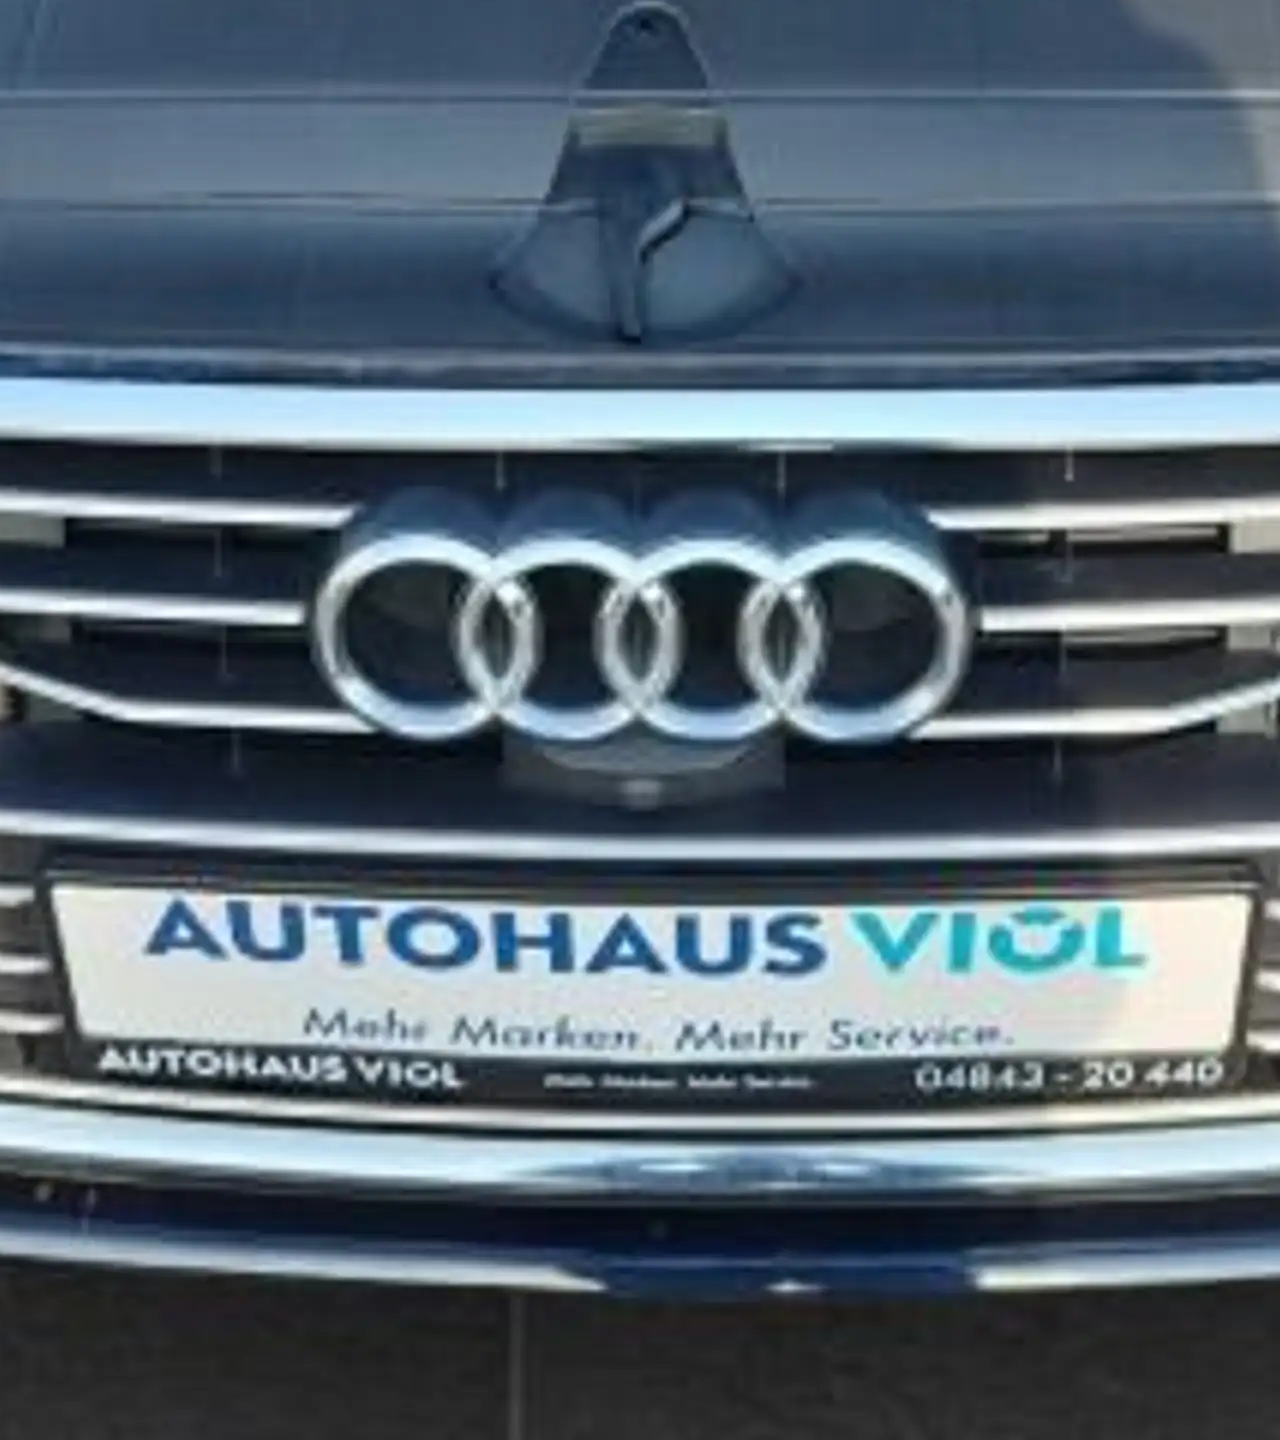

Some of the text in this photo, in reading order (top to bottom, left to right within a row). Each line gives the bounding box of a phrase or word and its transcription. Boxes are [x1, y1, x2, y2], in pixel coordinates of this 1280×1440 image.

[143, 898, 828, 978] AUTOHAUS
[303, 1007, 428, 1041] Mehr
[675, 1019, 808, 1053] Mehr
[98, 1046, 348, 1083] AUTOHAUS
[1082, 1060, 1135, 1090] 20
[1144, 1057, 1225, 1085] 440
